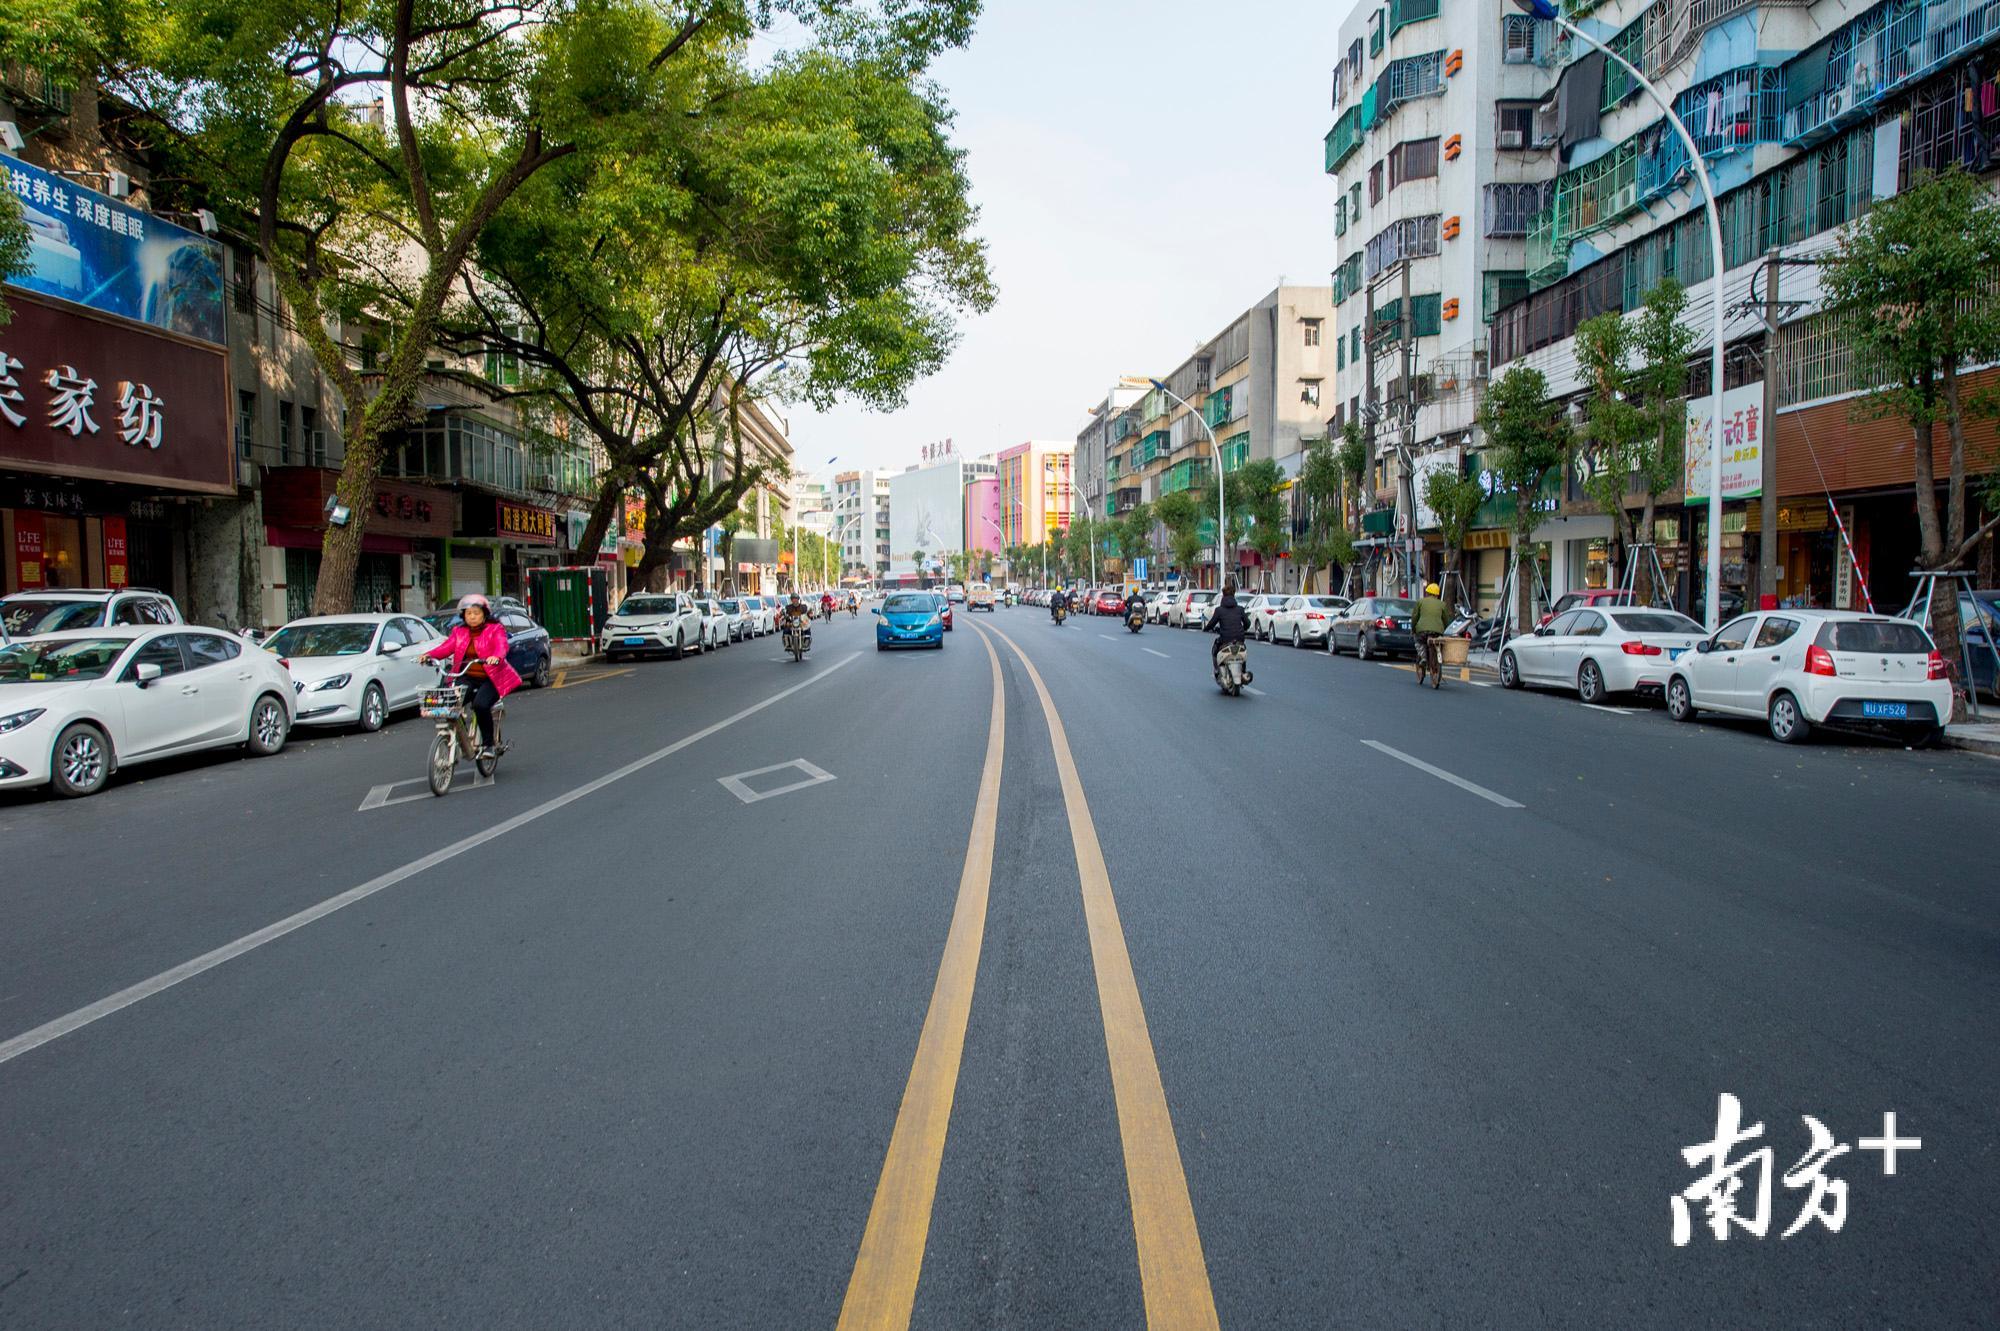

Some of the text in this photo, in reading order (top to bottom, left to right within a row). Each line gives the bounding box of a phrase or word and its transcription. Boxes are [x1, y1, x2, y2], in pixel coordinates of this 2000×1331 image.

[75, 195, 144, 242] 深度睡眠
[1878, 703, 1906, 716] XF526
